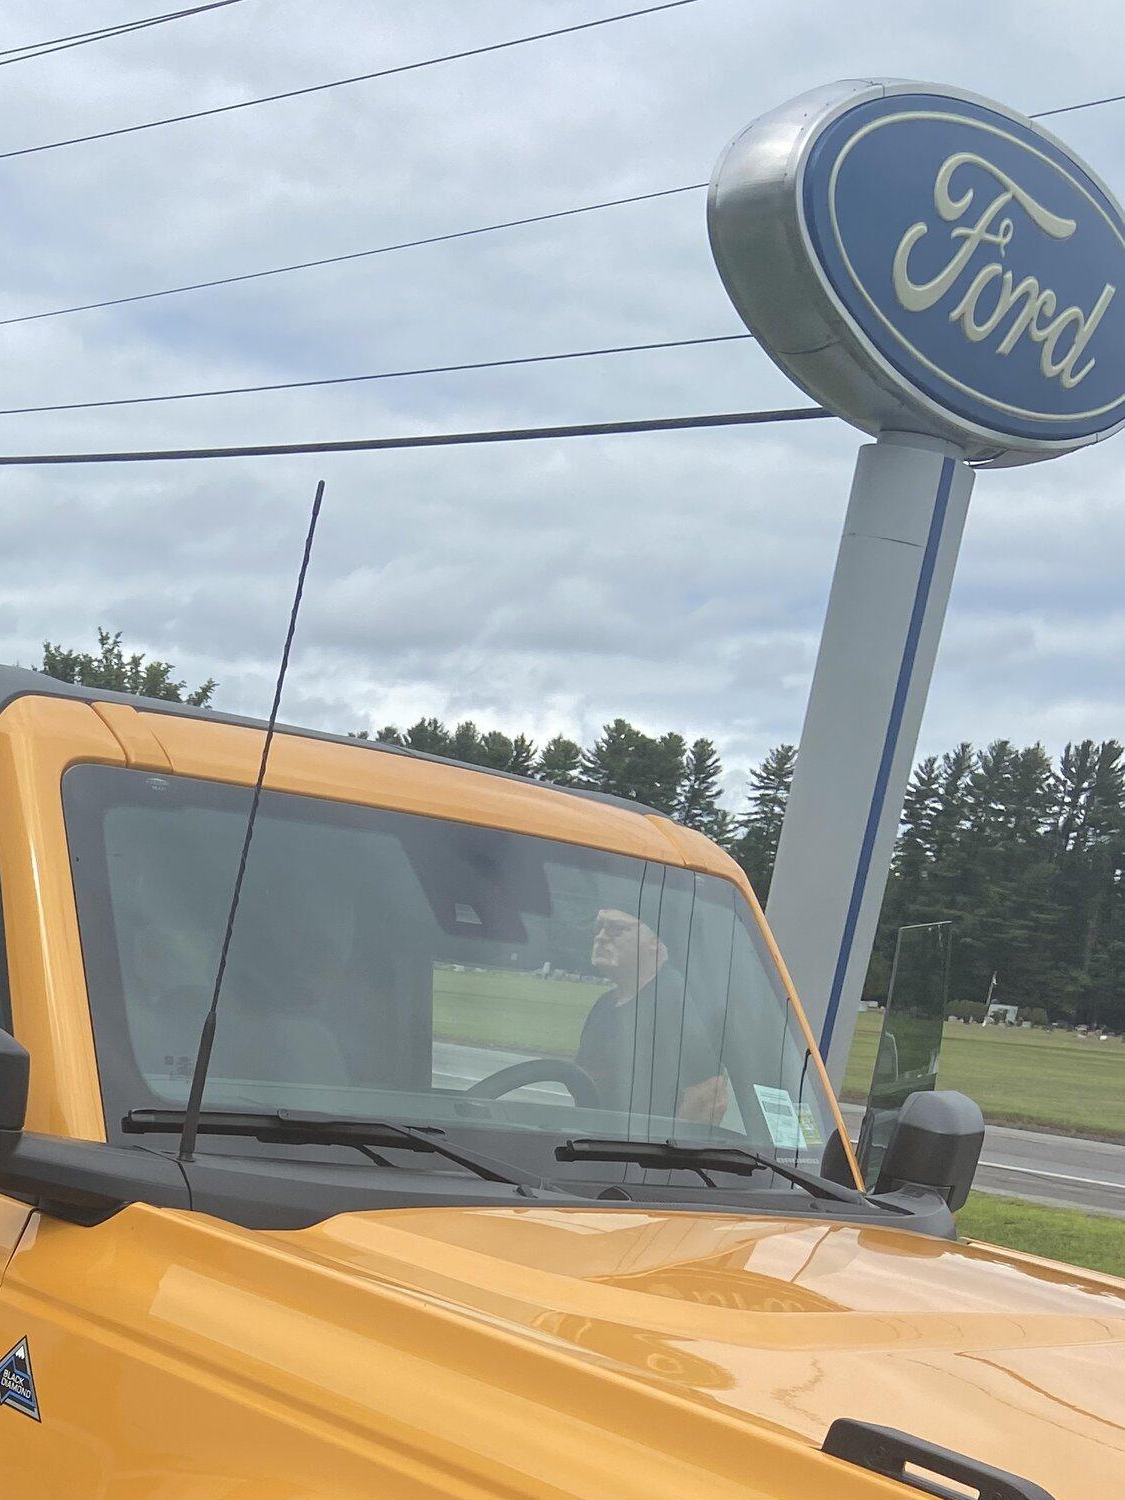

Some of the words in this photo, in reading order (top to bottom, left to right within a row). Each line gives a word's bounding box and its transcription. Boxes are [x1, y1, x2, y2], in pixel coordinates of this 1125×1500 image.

[892, 151, 1117, 389] Ford
[0, 1377, 32, 1399] DIAMOND
[2, 1368, 25, 1387] BLACK
